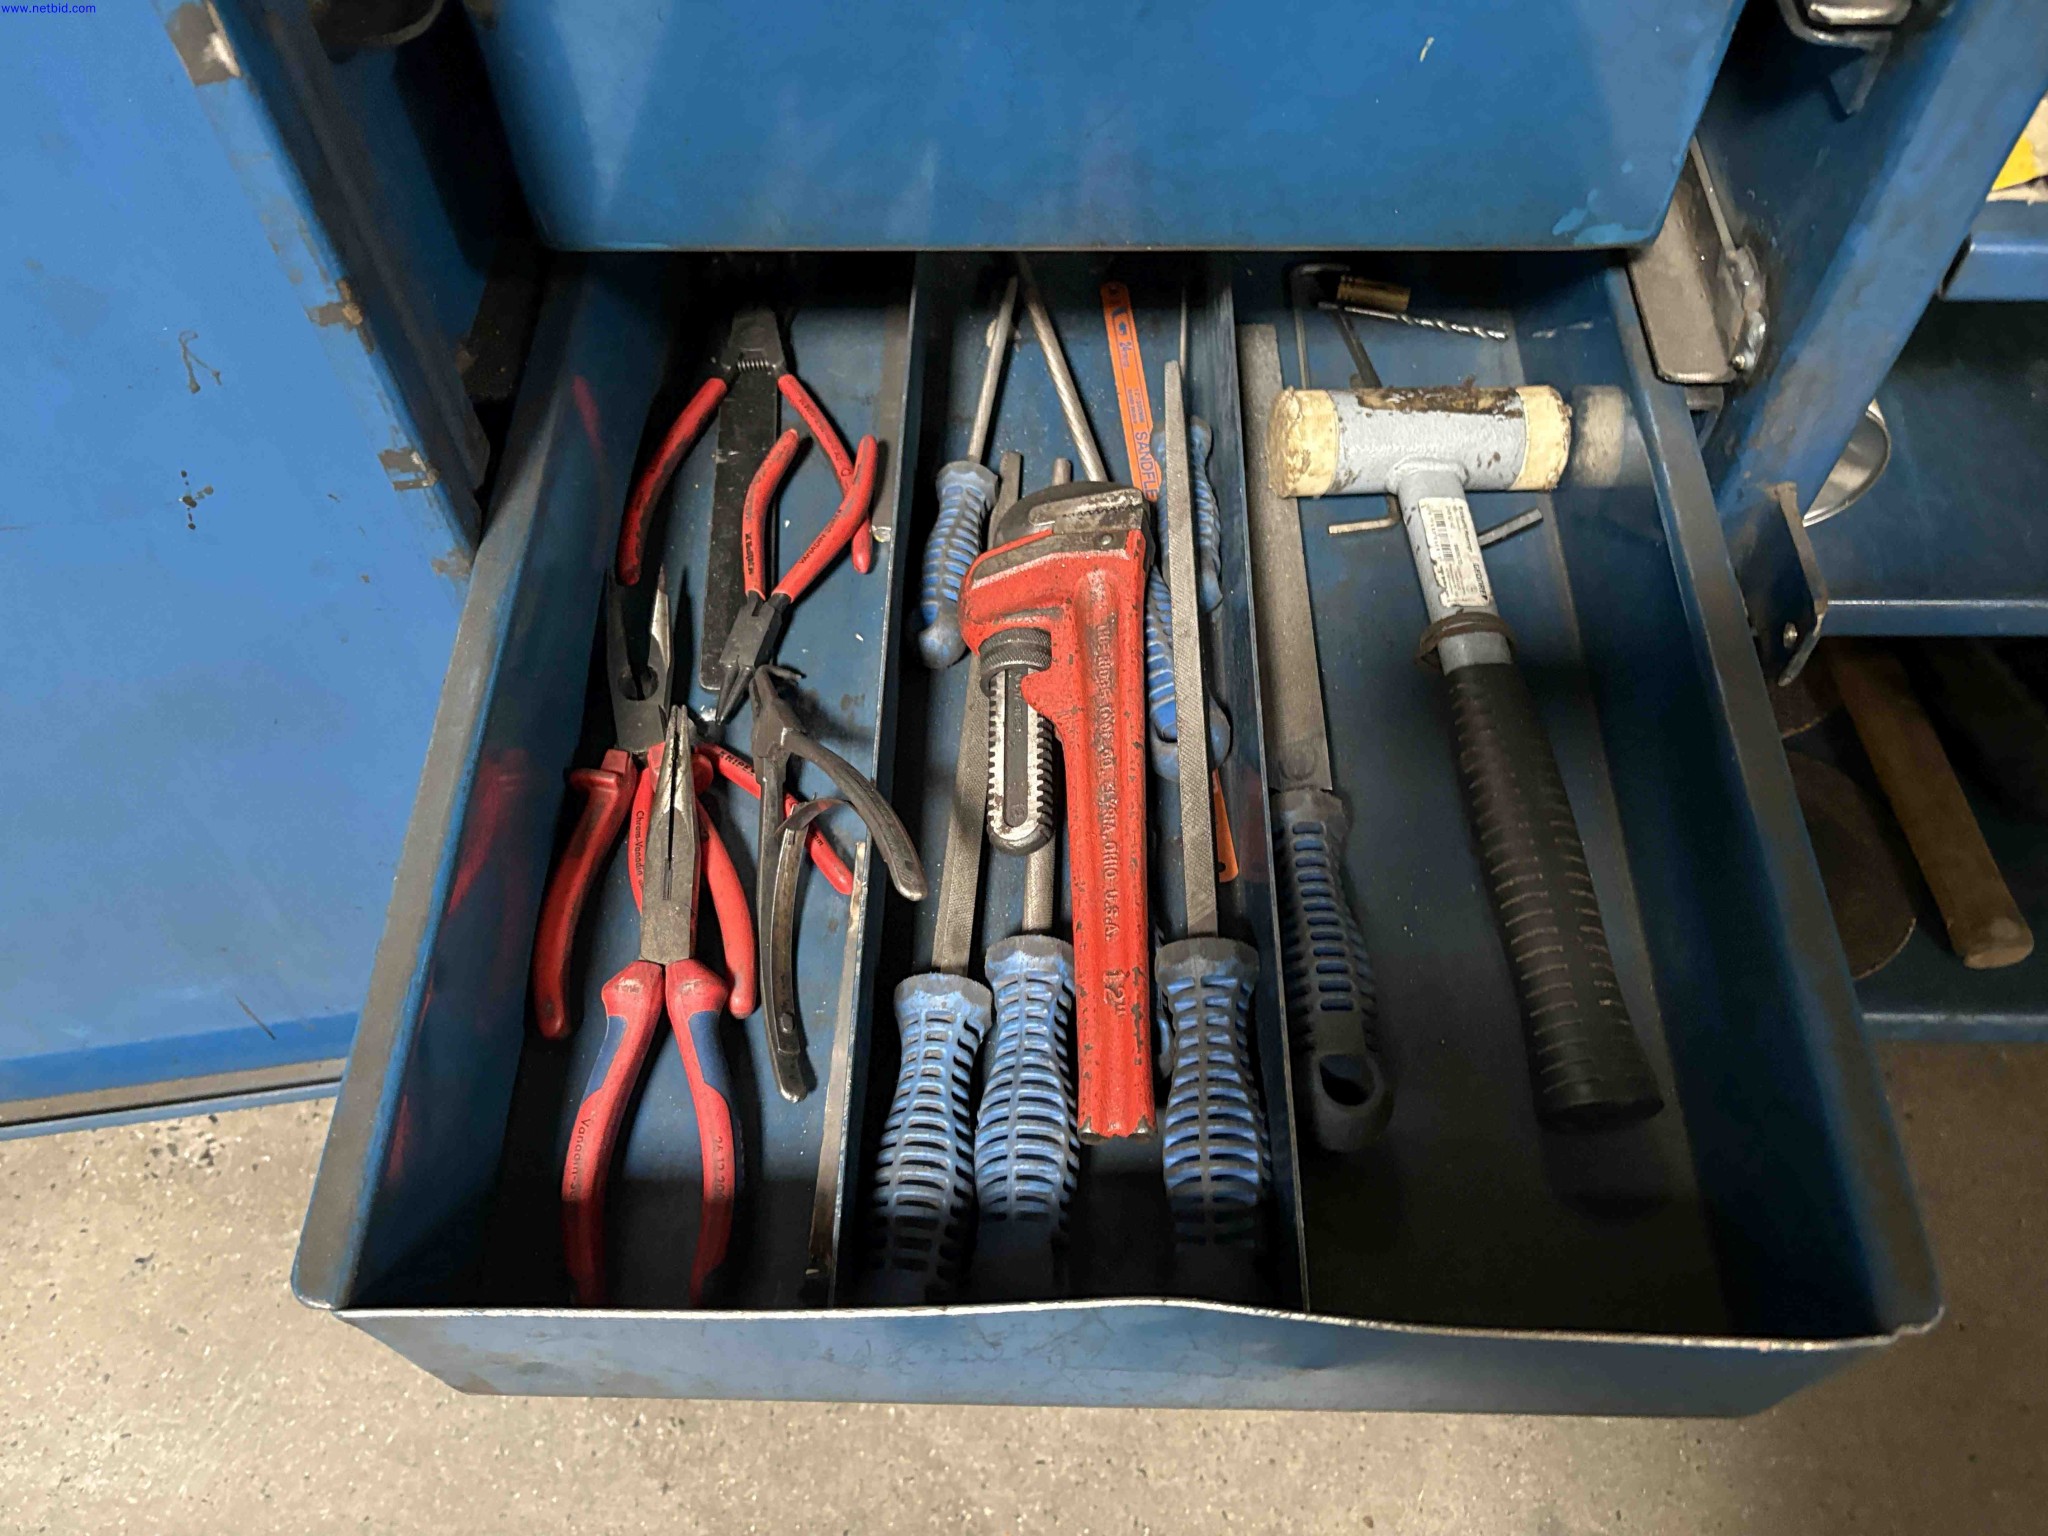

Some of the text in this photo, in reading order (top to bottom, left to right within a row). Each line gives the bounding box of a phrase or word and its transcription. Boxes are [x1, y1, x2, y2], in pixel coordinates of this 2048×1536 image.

[1135, 431, 1158, 500] SANDFLE
[798, 533, 826, 564] VANADIN
[634, 810, 645, 876] Chrom-Vanadin
[1102, 842, 1120, 881] OHIO
[1104, 888, 1120, 942] U.S.A.
[1103, 969, 1129, 1017] 12"
